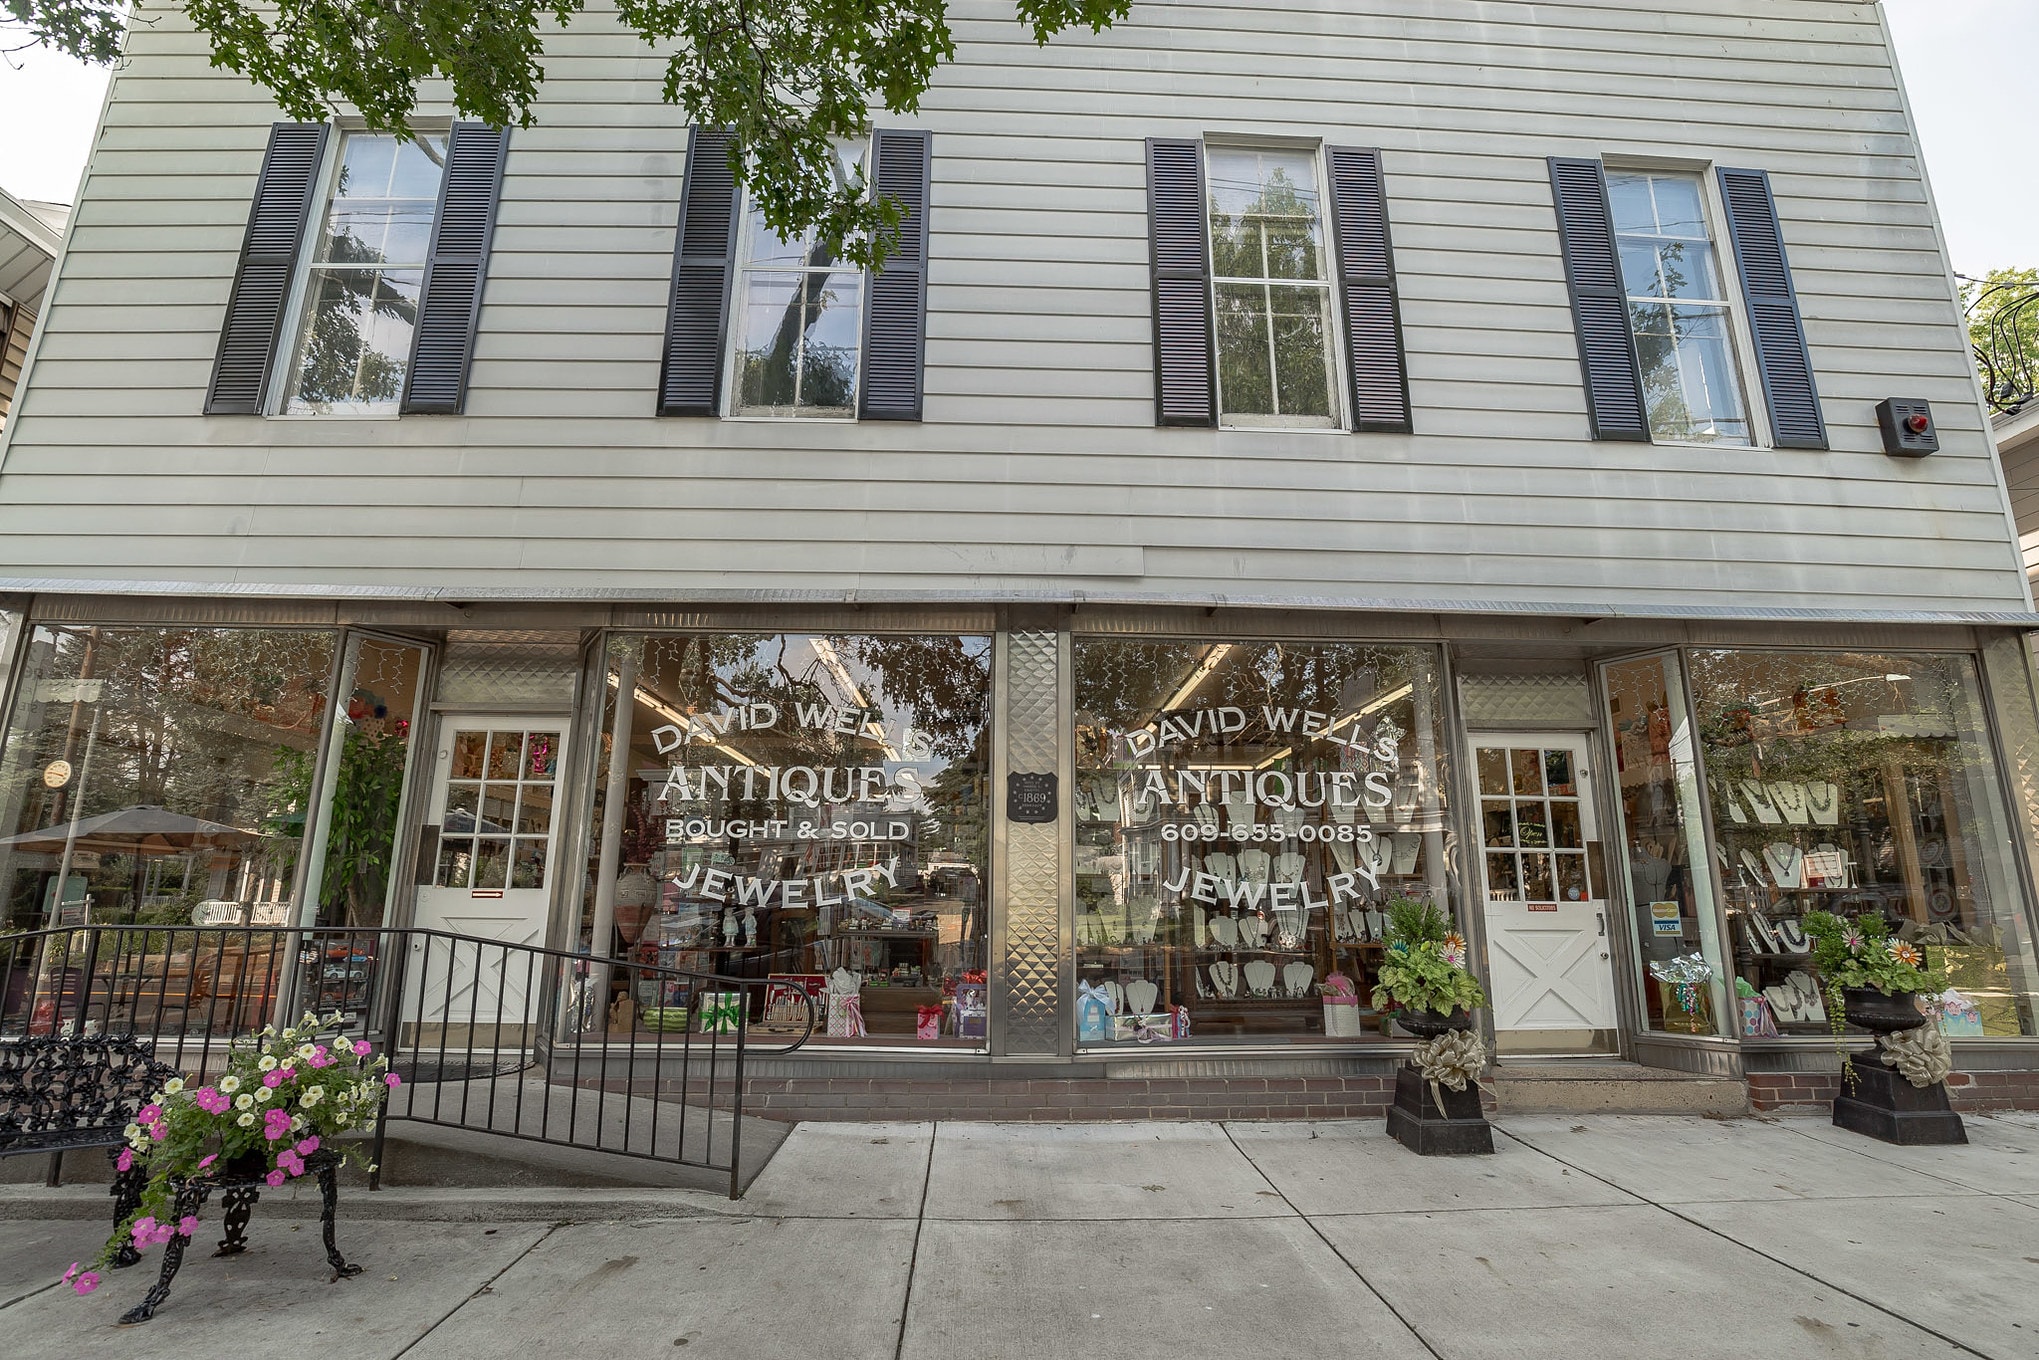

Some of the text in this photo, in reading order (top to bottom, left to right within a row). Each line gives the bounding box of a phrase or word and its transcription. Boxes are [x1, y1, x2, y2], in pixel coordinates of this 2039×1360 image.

[651, 702, 934, 758] DAVID WELLS
[1126, 705, 1399, 763] DAVID WELLS
[657, 765, 923, 807] ANTIQUES
[1023, 792, 1046, 803] 1869
[1138, 770, 1393, 812] ANTIQUES
[665, 819, 909, 840] BOUGHT & SOLD
[1161, 824, 1373, 843] 609-655-0085
[672, 856, 900, 909] JEWELRY
[1163, 860, 1382, 911] JEWELRY
